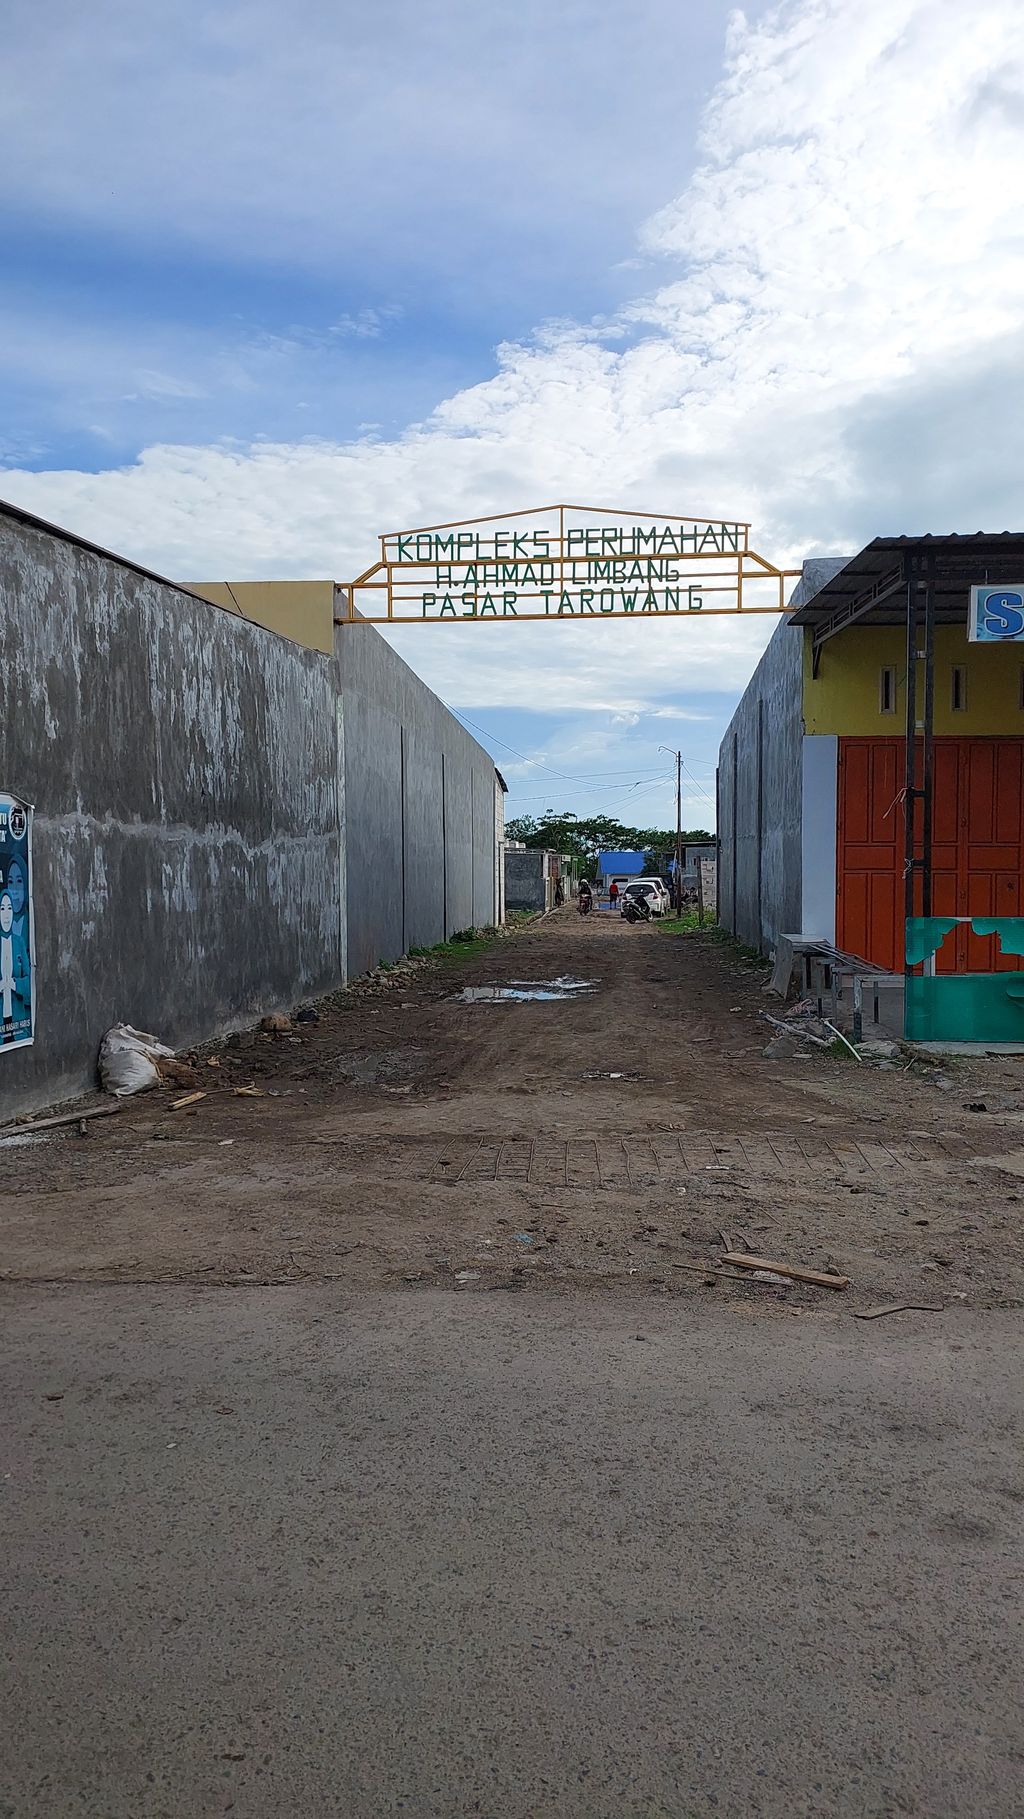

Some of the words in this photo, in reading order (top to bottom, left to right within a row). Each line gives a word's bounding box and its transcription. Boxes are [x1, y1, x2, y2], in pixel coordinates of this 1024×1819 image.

[398, 531, 550, 562] KOMPLEKS
[568, 524, 738, 557] PERUMAHAN
[572, 558, 680, 585] LIMBANG
[422, 590, 518, 617] PASAR
[540, 585, 703, 614] TAROWANG
